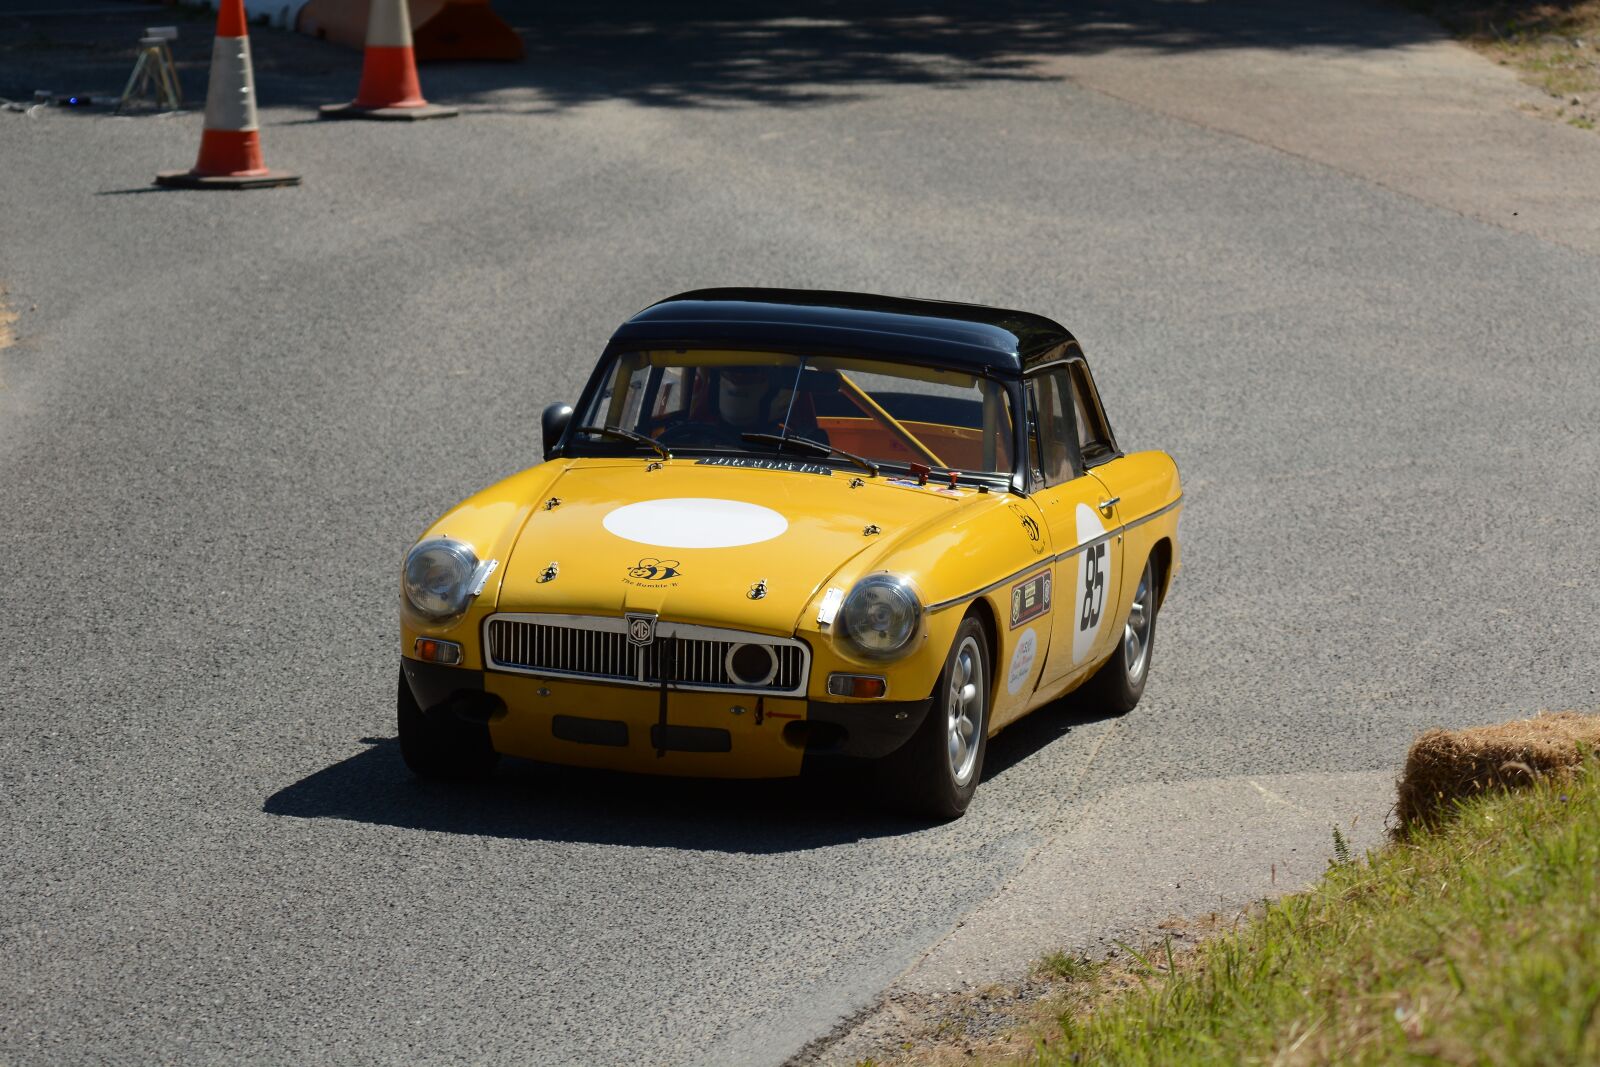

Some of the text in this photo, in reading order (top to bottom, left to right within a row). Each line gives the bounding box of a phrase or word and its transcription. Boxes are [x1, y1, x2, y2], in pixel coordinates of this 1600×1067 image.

[620, 578, 635, 586] The
[1080, 542, 1105, 632] 85
[633, 622, 648, 638] MG
